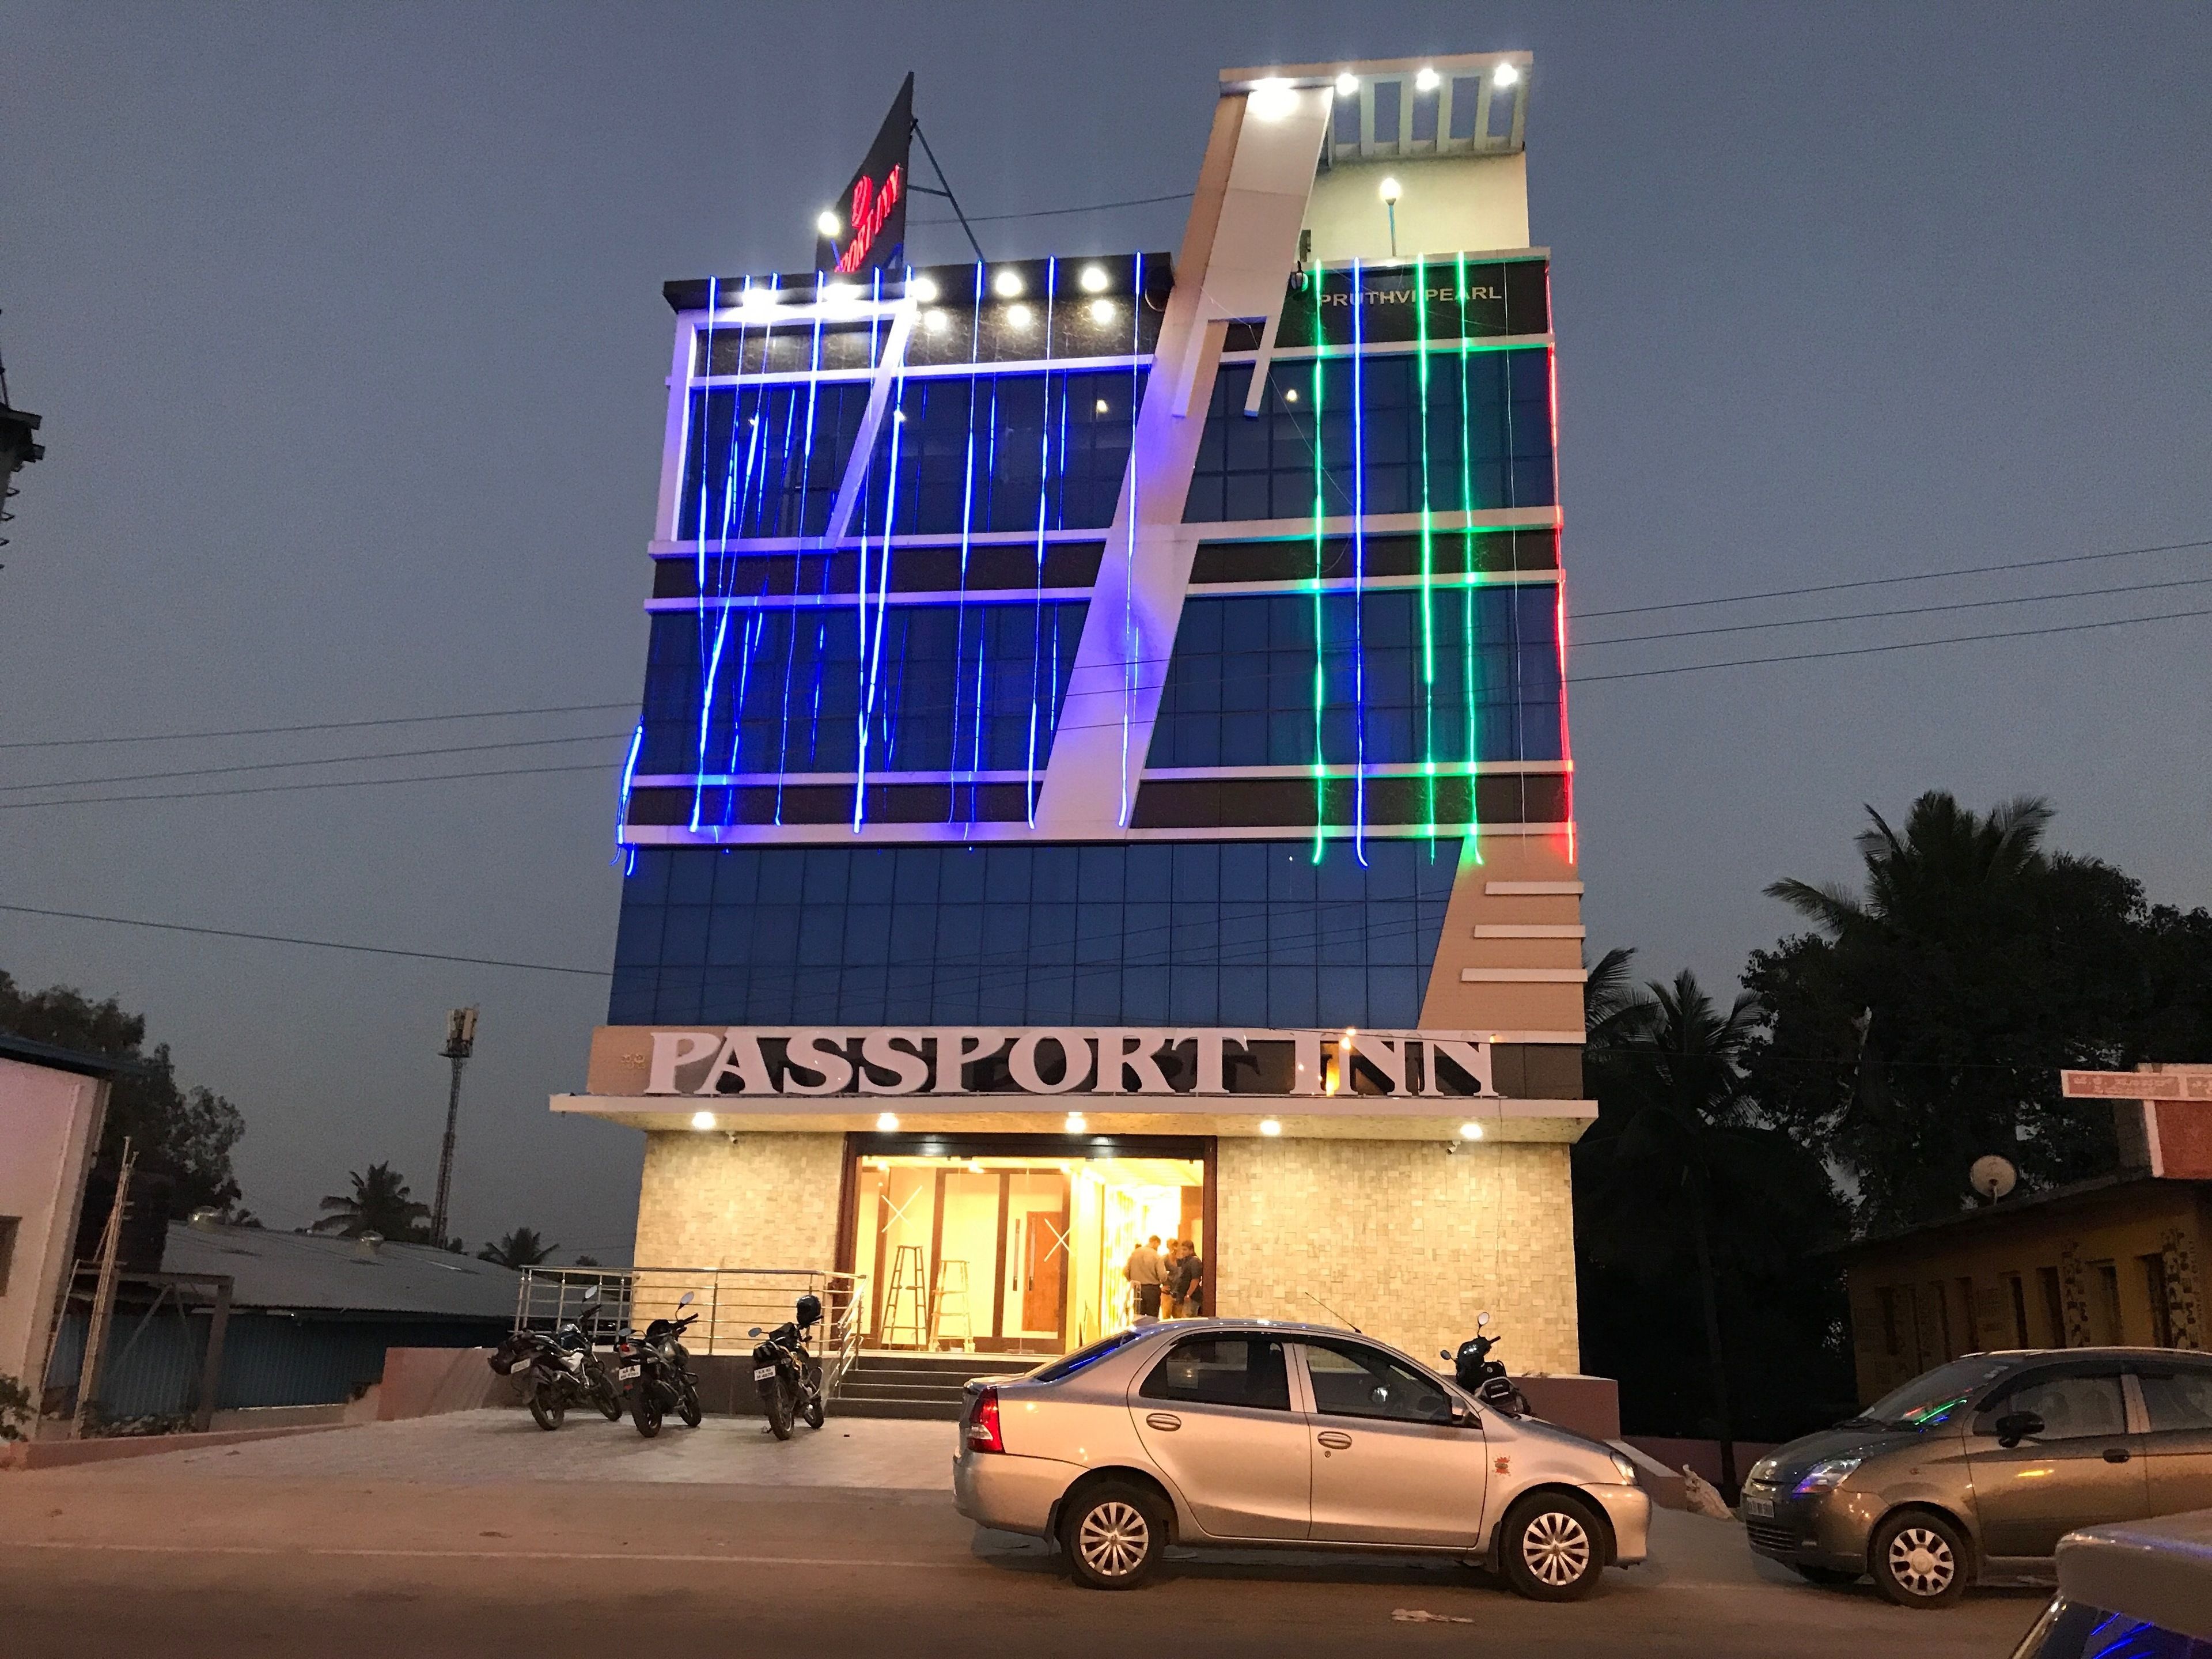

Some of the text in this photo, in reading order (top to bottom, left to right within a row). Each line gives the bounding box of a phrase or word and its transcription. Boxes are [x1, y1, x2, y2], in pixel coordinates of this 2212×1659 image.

[834, 208, 874, 272] PORT
[1320, 290, 1416, 306] PRUTHVI
[643, 1028, 1500, 1096] PASSPORT INN
